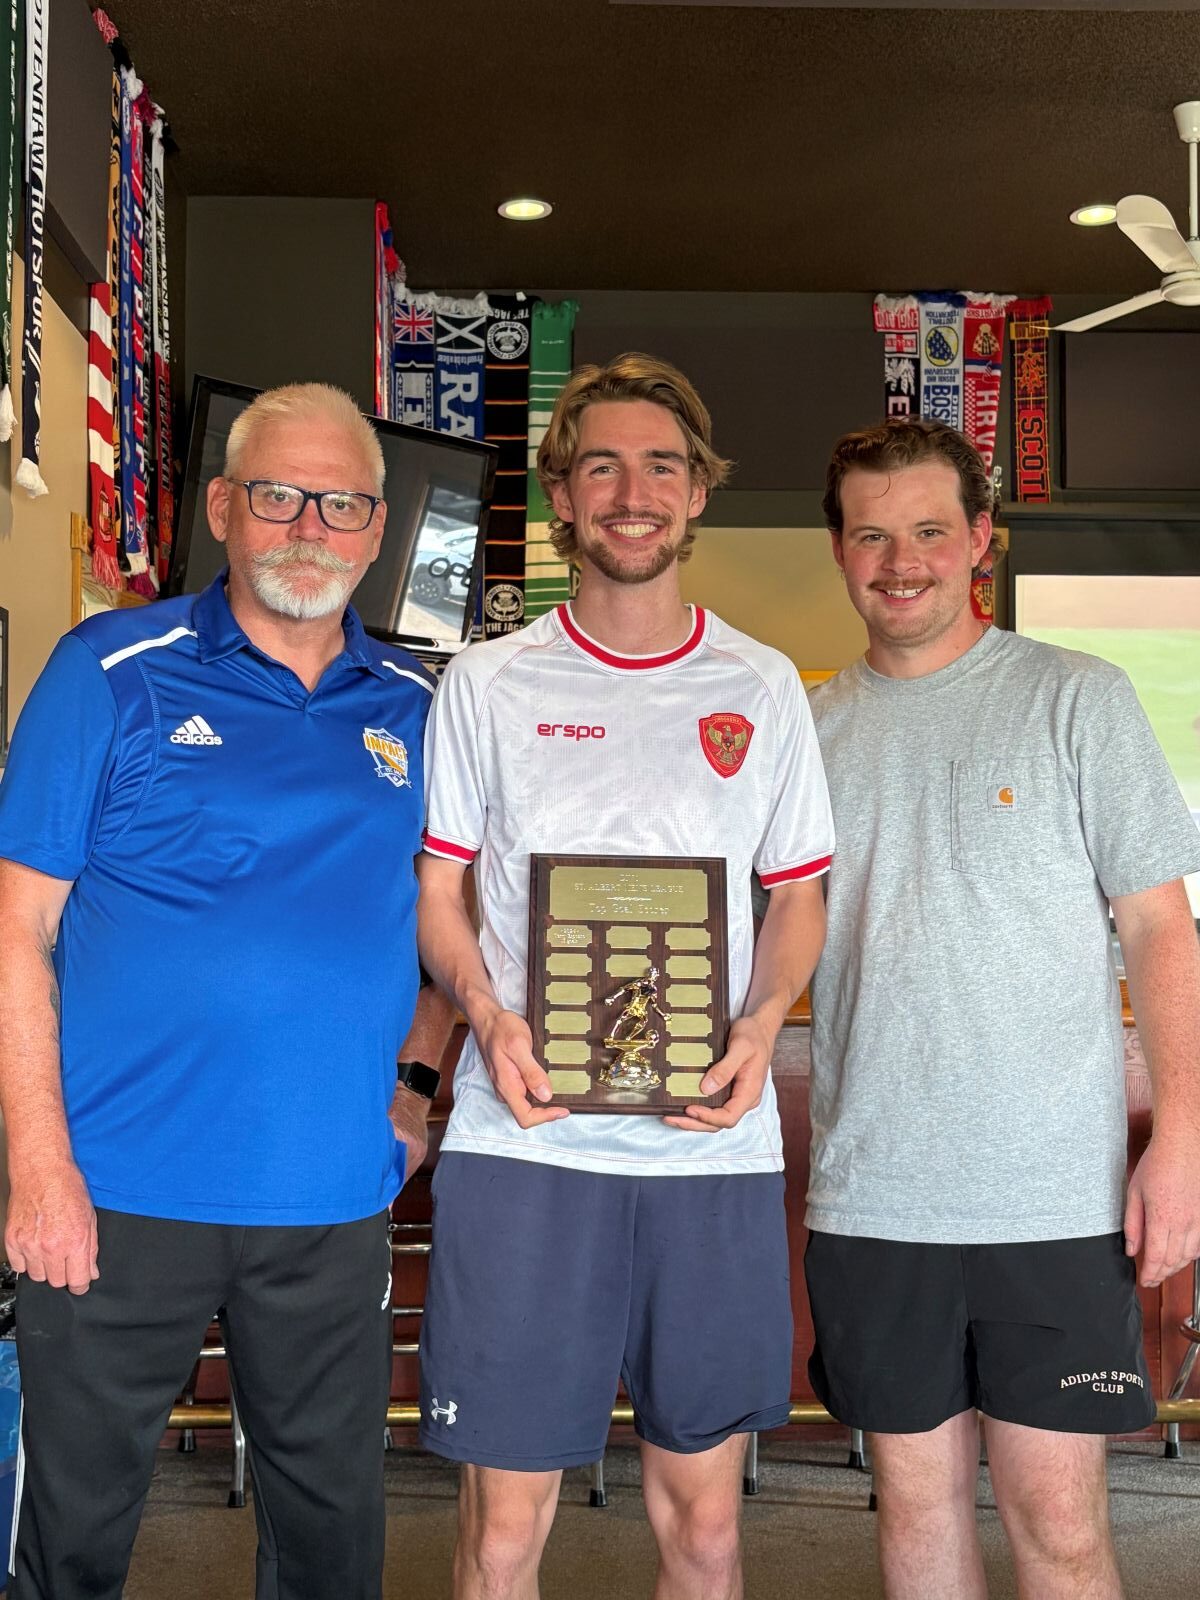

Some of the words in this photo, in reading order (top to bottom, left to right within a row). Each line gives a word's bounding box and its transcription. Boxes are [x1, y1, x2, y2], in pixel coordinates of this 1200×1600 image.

[33, 0, 44, 170] OTTENHAM
[32, 186, 44, 340] HOTSPUR
[486, 622, 502, 634] THE
[169, 733, 223, 746] adidas
[537, 722, 606, 741] erspo
[363, 733, 408, 762] IMPACT
[1060, 1371, 1107, 1389] ADIDAS
[1092, 1382, 1125, 1394] CLUB
